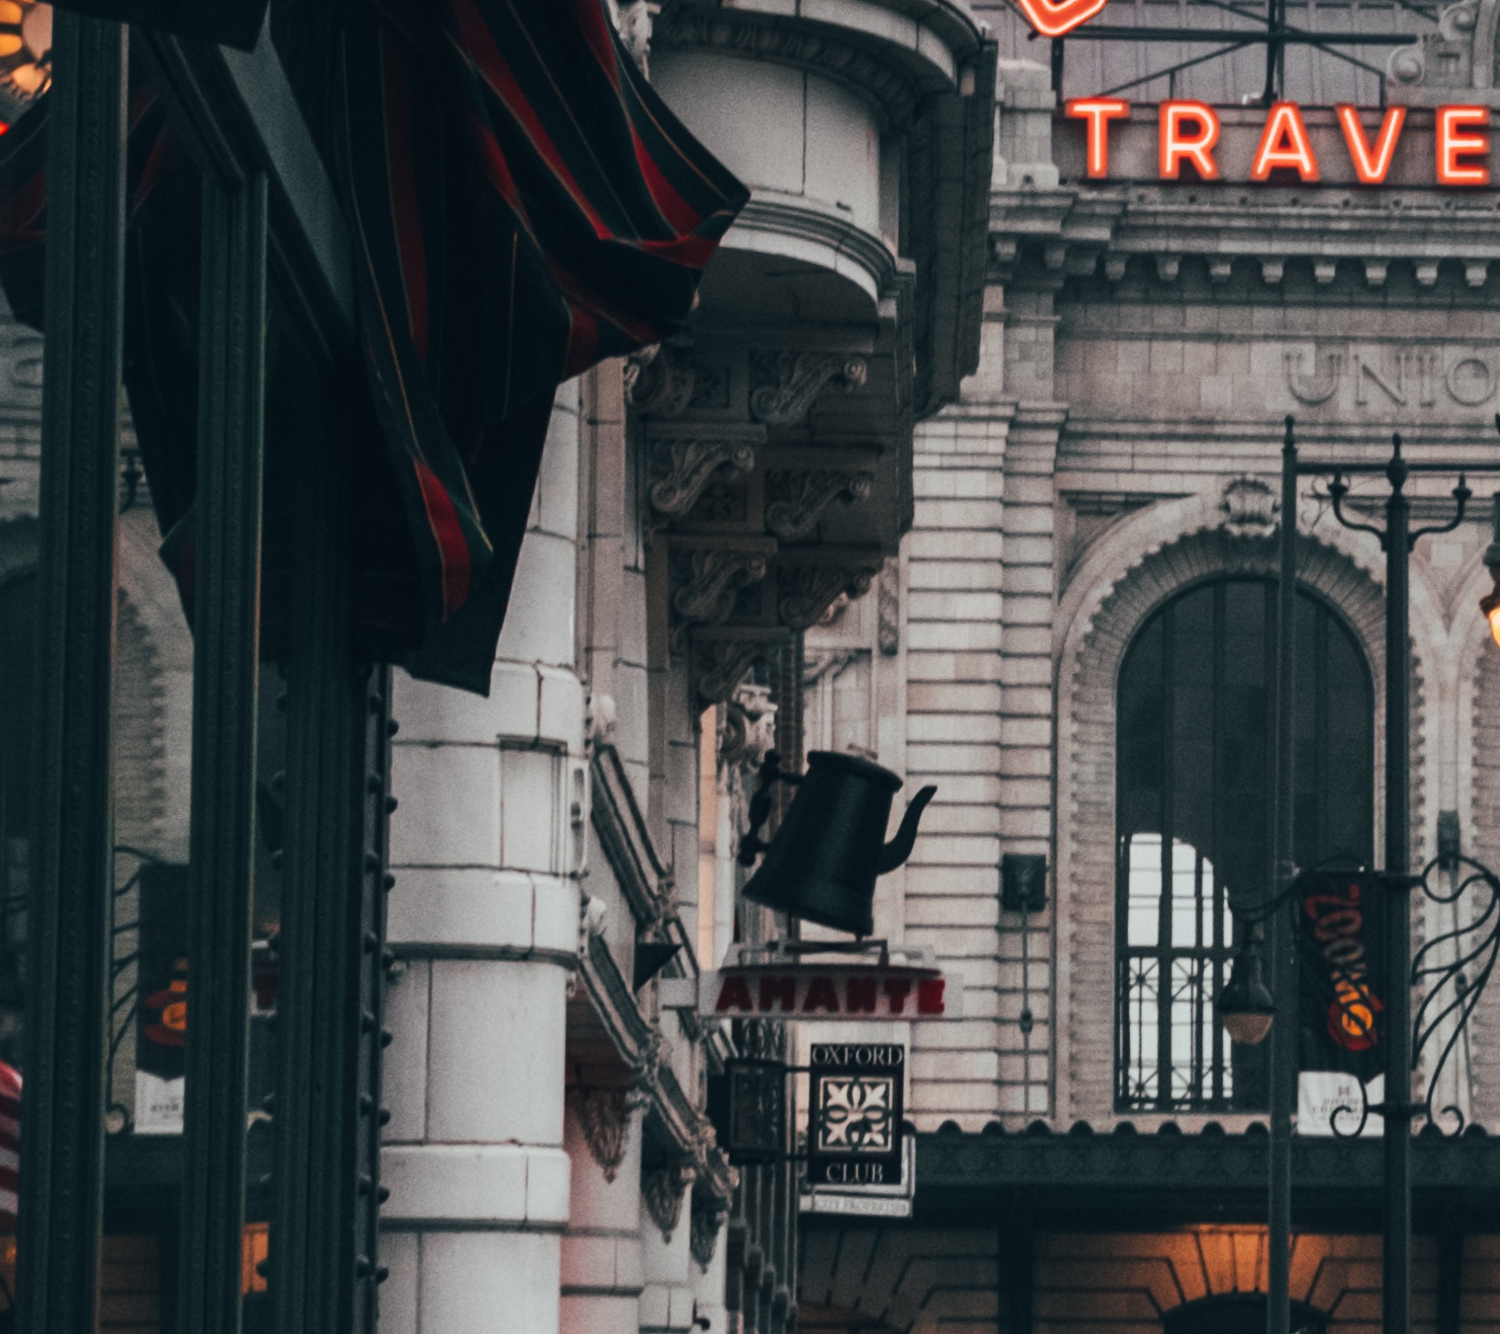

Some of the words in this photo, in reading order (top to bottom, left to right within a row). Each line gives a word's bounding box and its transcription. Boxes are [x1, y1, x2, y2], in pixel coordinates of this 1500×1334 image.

[715, 976, 947, 1015] AMANTE
[812, 1044, 905, 1067] OXFORD
[826, 1161, 884, 1183] CLUB
